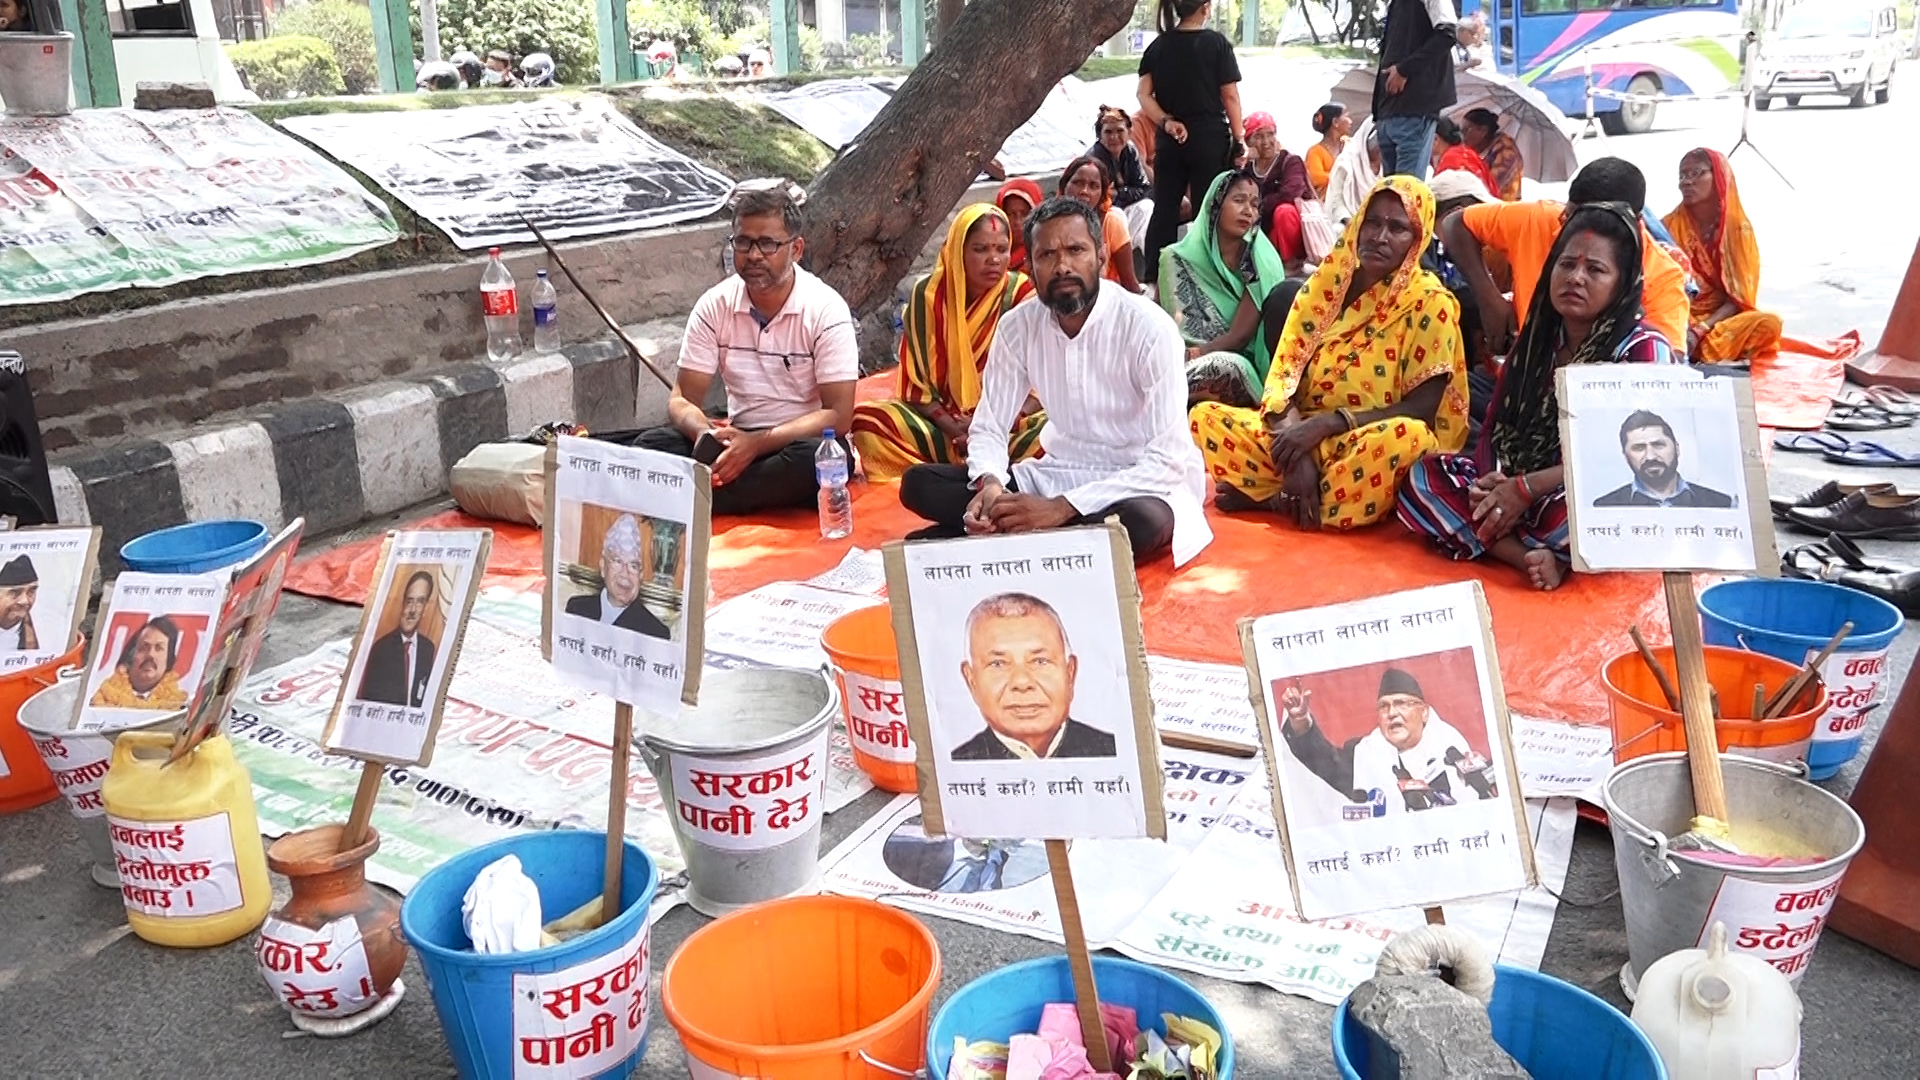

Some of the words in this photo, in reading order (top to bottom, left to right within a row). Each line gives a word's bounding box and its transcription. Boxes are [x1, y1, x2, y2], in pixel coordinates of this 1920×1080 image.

[924, 565, 971, 580] लापता
[982, 558, 1031, 576] लापता
[1042, 554, 1093, 570] लापता
[1272, 629, 1325, 650] लापता
[1336, 618, 1390, 640] लापता
[1400, 606, 1457, 628] लापता
[852, 715, 908, 748] पानी
[1047, 775, 1084, 796] हामी
[679, 799, 755, 836] पानी
[766, 792, 811, 829] देउ
[1413, 837, 1450, 860] हामी
[519, 1012, 618, 1066] पानी
